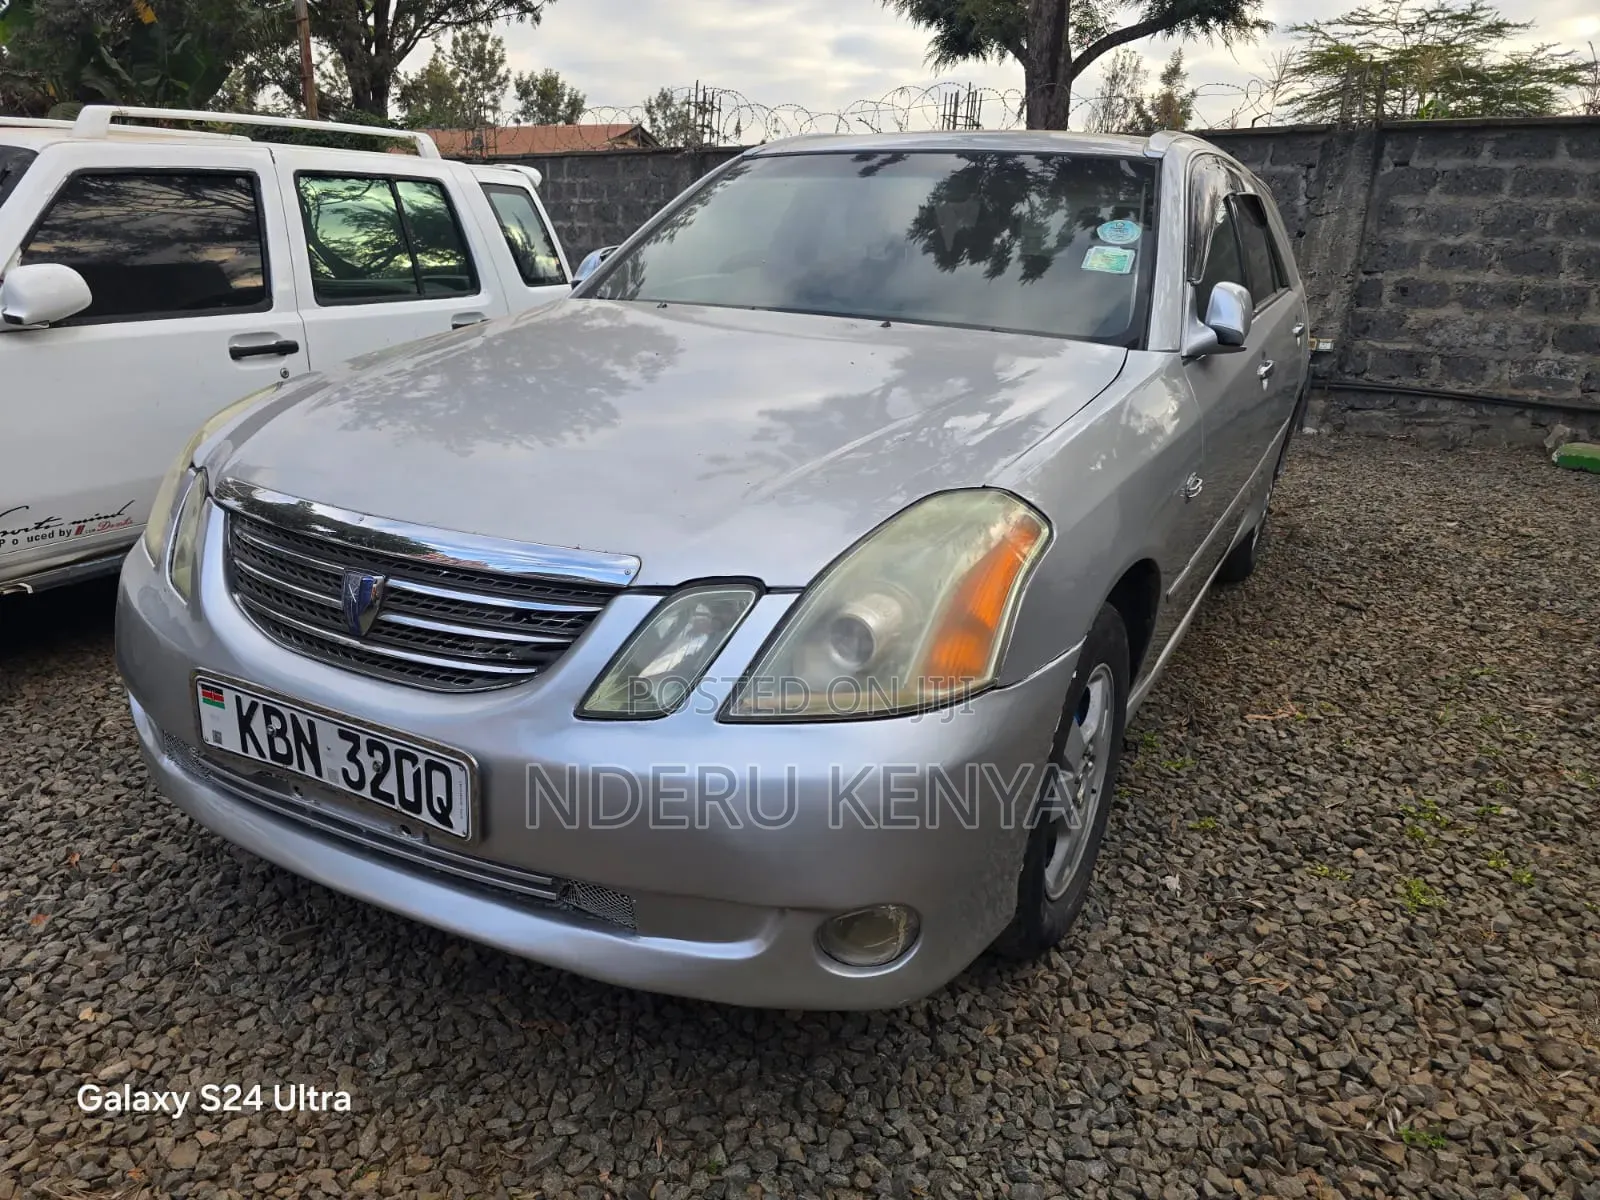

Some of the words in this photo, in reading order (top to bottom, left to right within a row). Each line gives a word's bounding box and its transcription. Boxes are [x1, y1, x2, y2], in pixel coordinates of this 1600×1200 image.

[59, 529, 72, 538] by
[235, 695, 323, 778] KBN
[338, 728, 453, 828] 320Q
